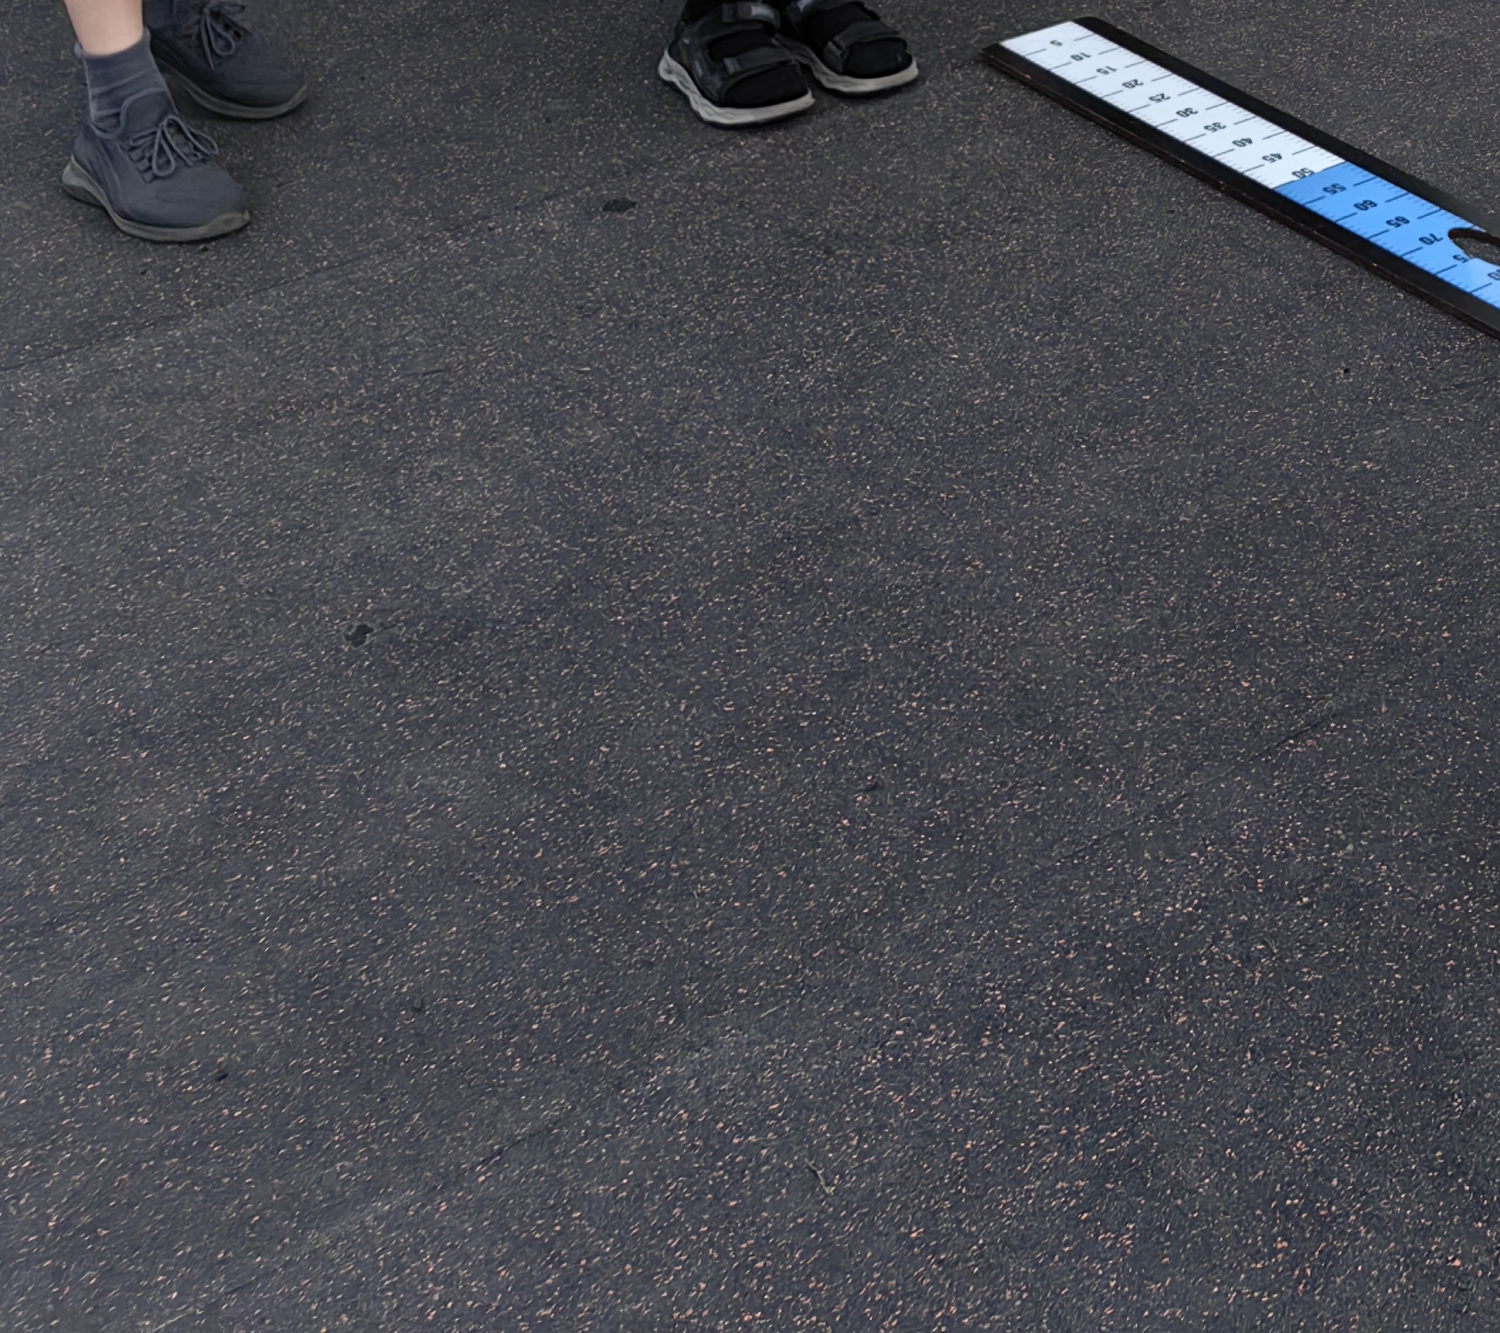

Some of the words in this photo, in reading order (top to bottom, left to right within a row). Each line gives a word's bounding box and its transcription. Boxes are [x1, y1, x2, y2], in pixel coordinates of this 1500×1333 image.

[1050, 39, 1063, 47] 5
[1071, 53, 1091, 61] 10
[1096, 66, 1117, 75] 15
[1122, 79, 1144, 89] 20
[1149, 92, 1171, 103] 25
[1176, 107, 1198, 118] 30
[1204, 121, 1226, 132] 35
[1232, 137, 1253, 148] 40
[1262, 152, 1283, 163] 45
[1292, 167, 1315, 179] 50
[1323, 182, 1346, 195] 55
[1354, 199, 1378, 211] 60
[1386, 215, 1410, 228] 65
[1419, 233, 1443, 246] 70
[1453, 253, 1473, 263] 5
